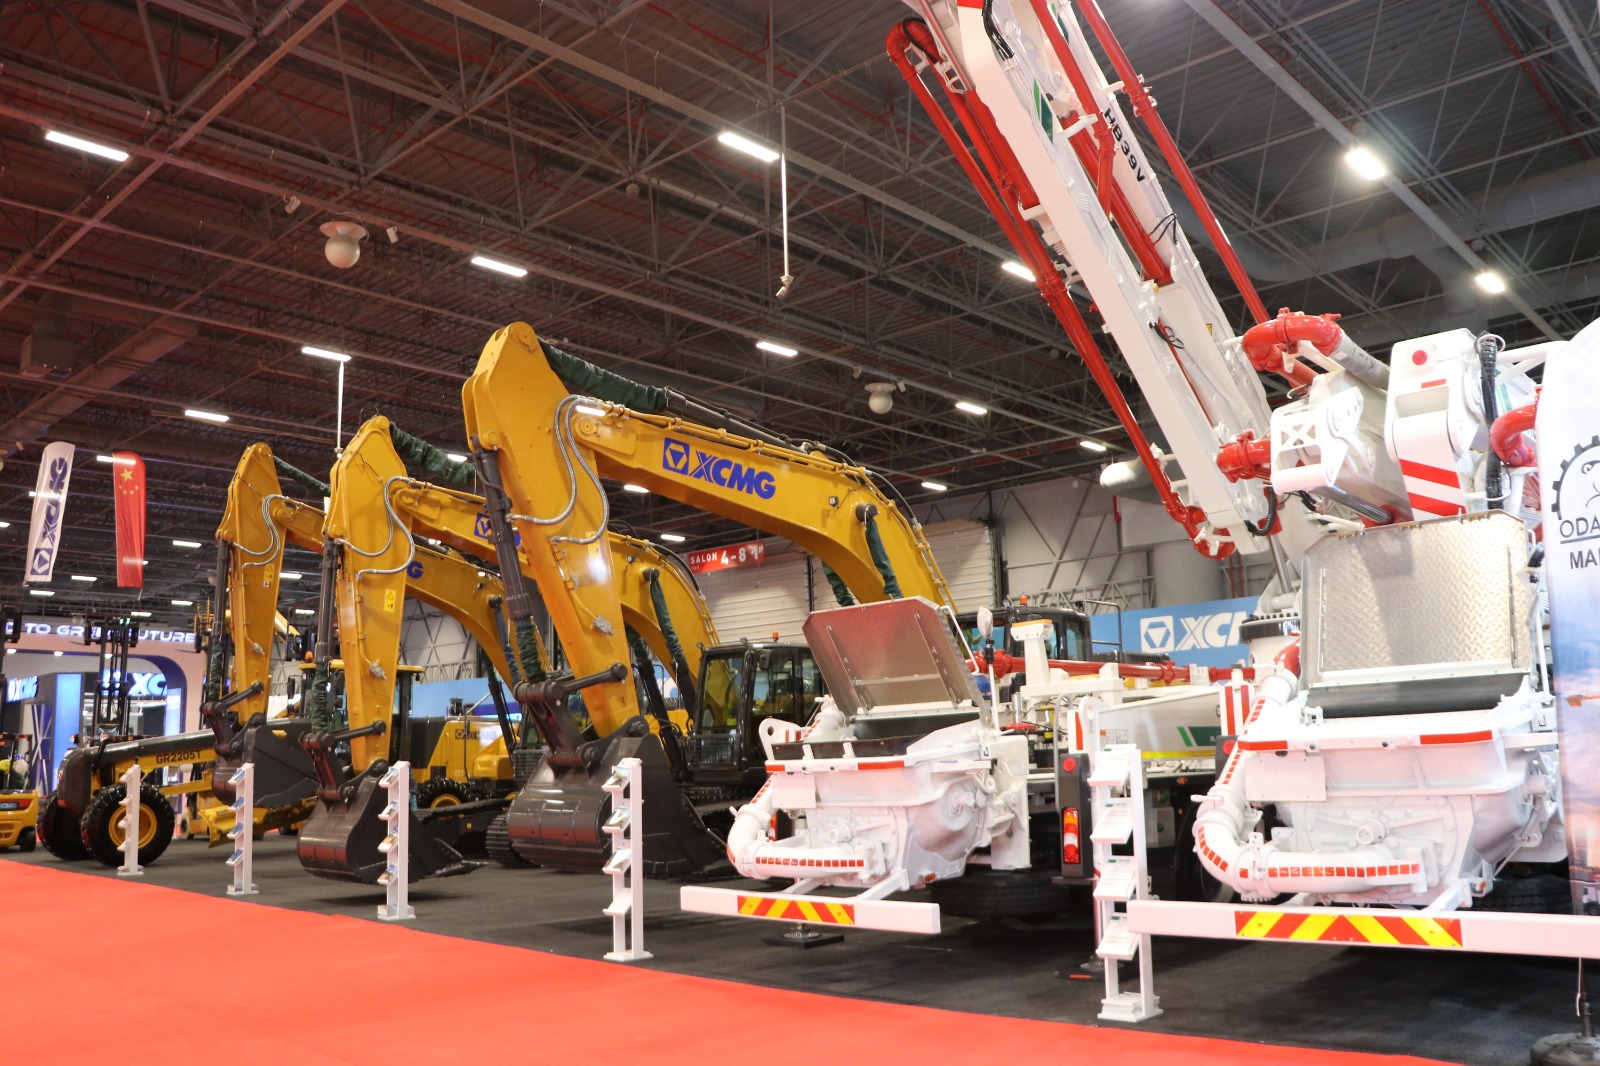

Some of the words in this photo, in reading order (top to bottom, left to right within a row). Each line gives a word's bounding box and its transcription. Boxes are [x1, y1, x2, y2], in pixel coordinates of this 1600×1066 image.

[1104, 108, 1146, 182] HB39V
[689, 450, 776, 499] XCMG
[690, 552, 718, 565] SALON
[1570, 548, 1600, 569] MA
[24, 623, 52, 635] TO
[156, 749, 202, 764] GR2205T
